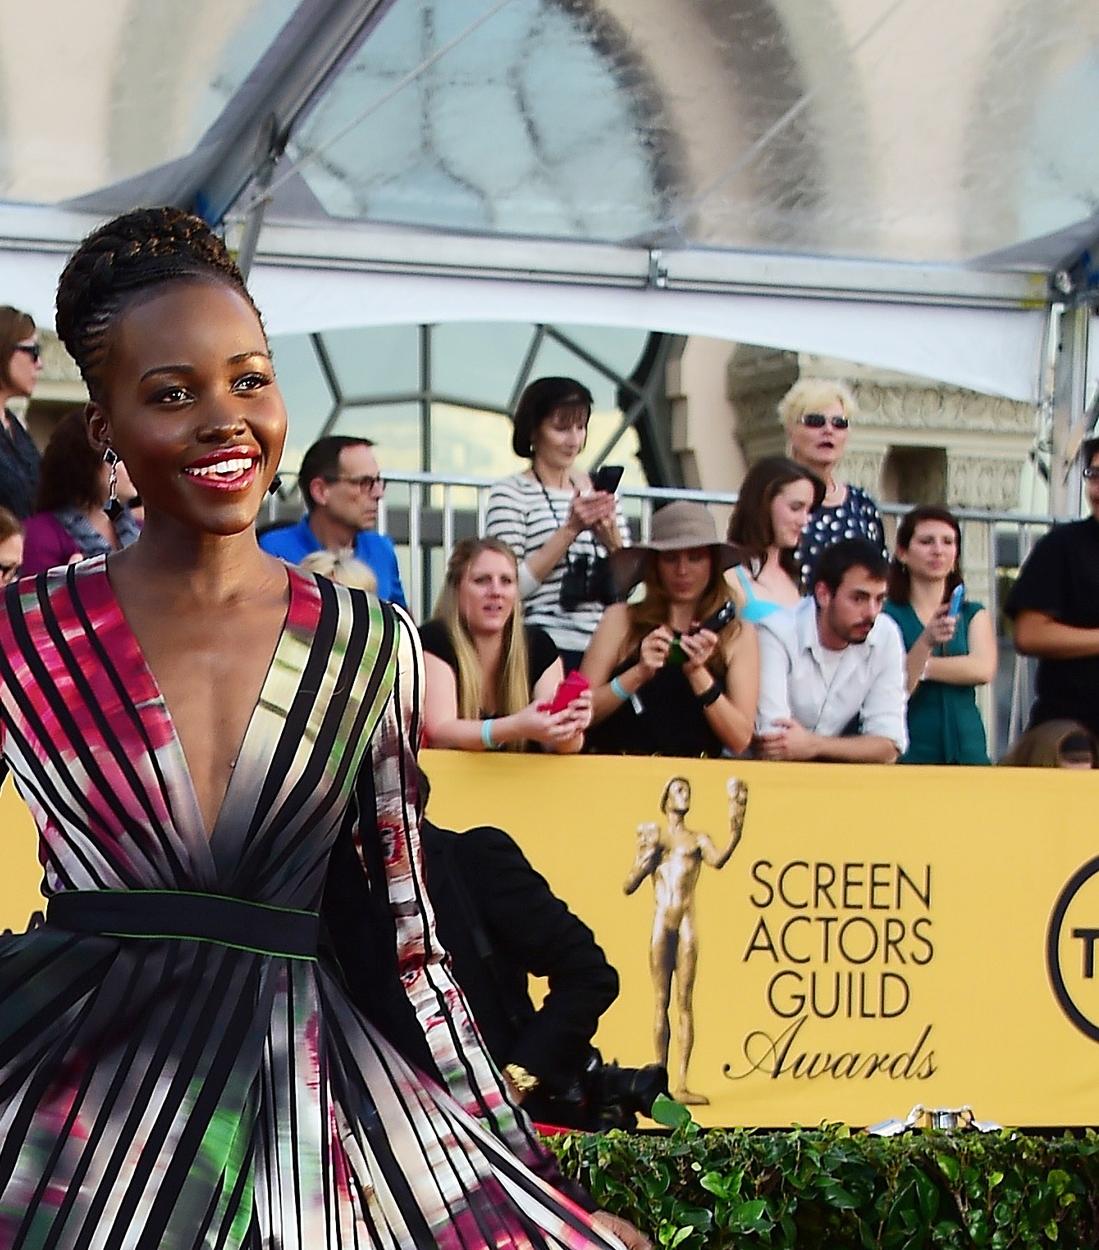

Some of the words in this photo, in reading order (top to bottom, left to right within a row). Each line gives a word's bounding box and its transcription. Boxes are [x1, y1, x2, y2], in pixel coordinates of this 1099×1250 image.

[749, 860, 932, 911] SCREEN
[742, 915, 935, 966] ACTORS
[767, 970, 911, 1020] GUILD
[723, 1014, 939, 1081] Awards
